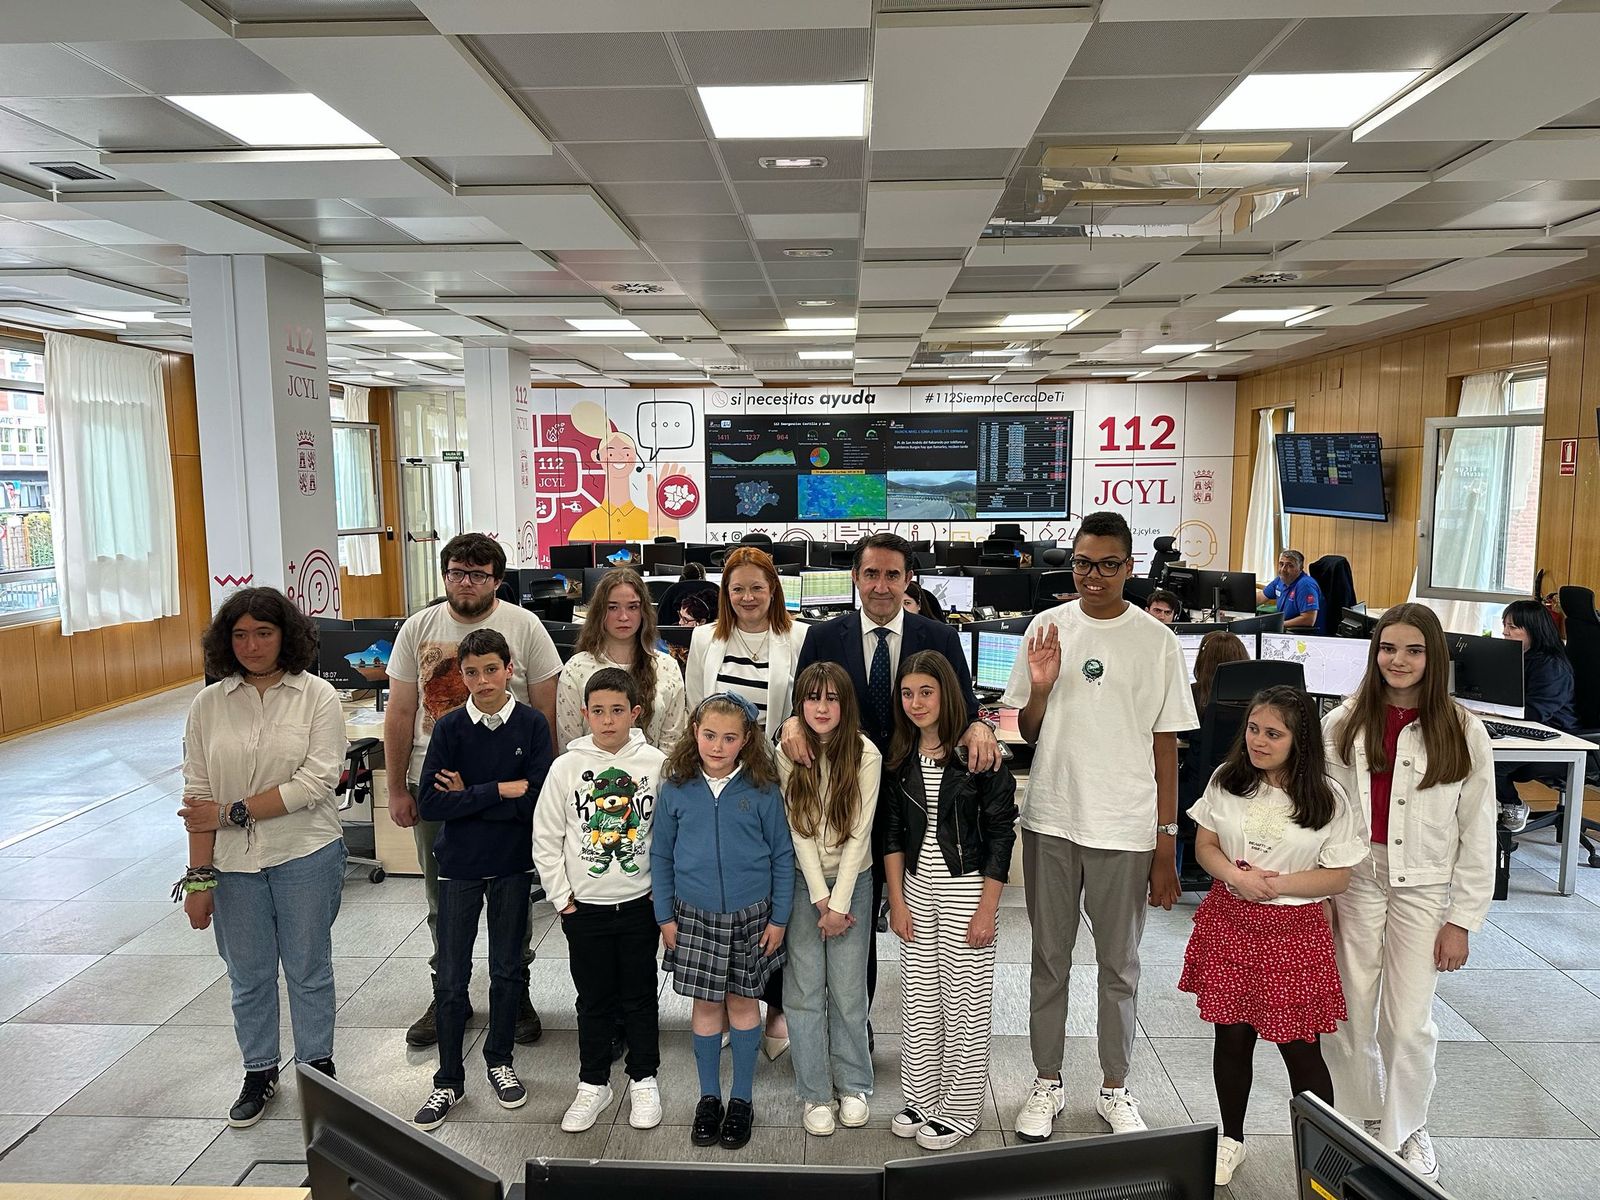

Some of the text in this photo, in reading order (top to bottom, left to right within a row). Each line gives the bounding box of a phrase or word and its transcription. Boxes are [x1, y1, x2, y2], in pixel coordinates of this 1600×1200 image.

[284, 322, 316, 357] 112
[287, 375, 319, 400] JCYL
[515, 385, 528, 405] 112
[730, 389, 876, 408] si necesitas ayuda
[924, 391, 1065, 405] #112SiempreCercaDeTi
[1098, 414, 1176, 451] 112
[538, 457, 565, 470] 112
[538, 477, 566, 488] JCYL
[1094, 478, 1176, 506] JCYL
